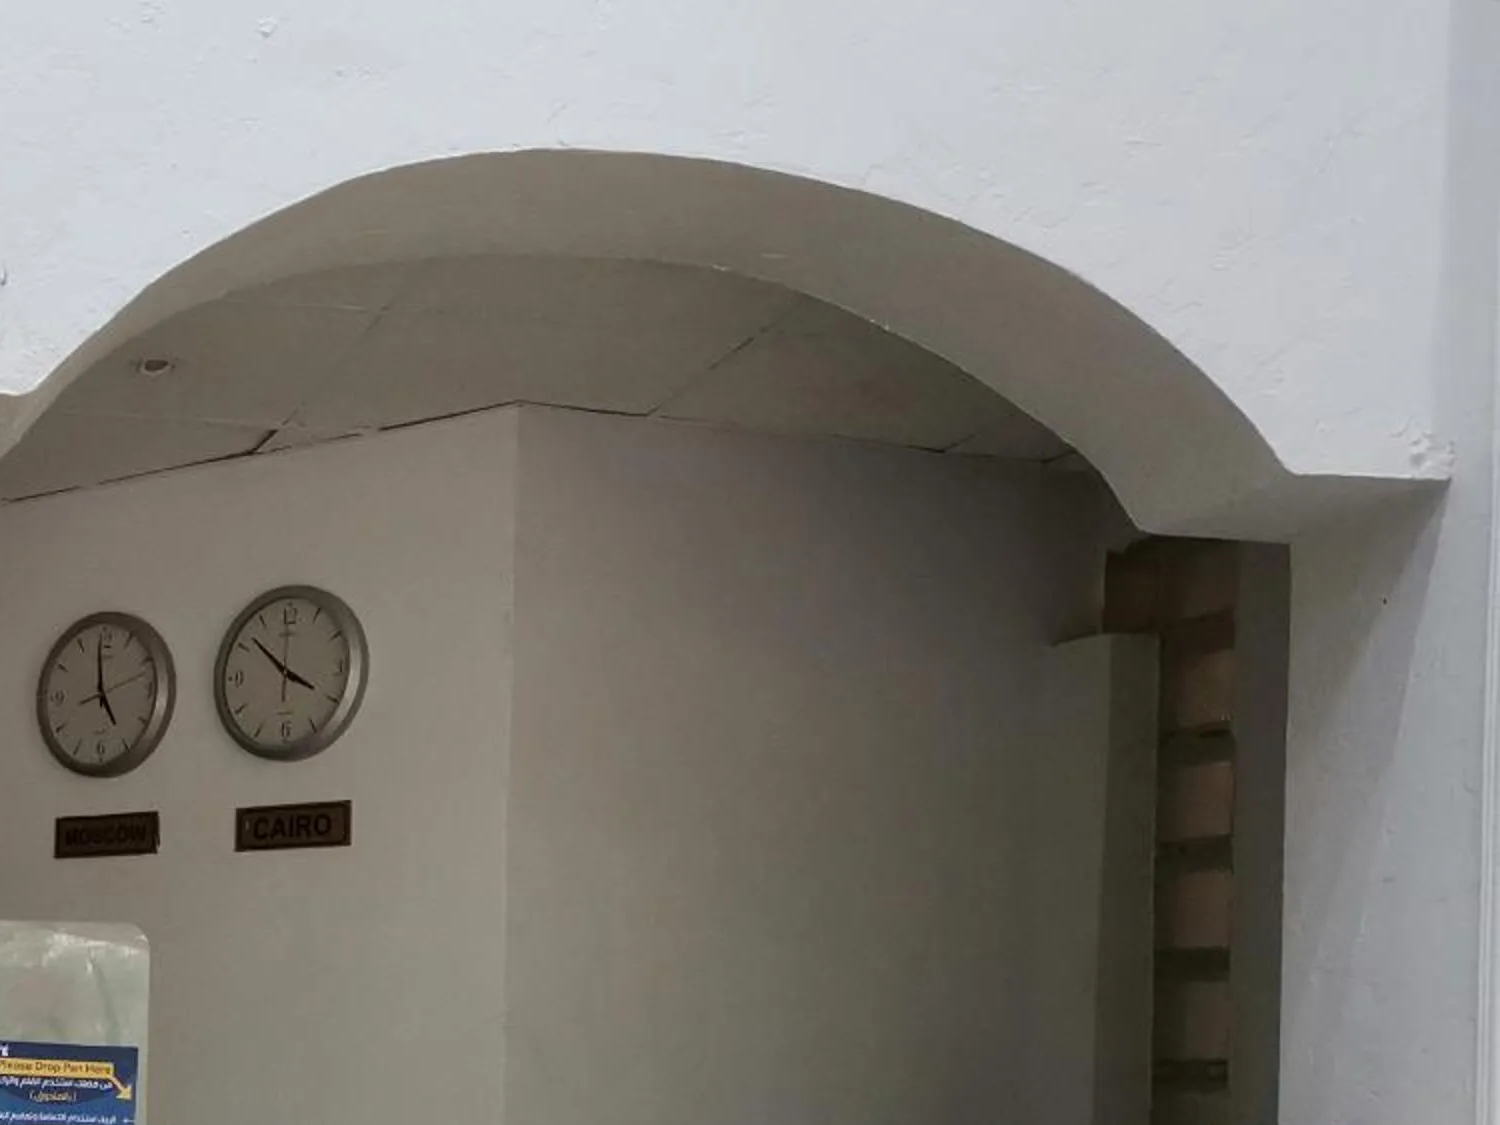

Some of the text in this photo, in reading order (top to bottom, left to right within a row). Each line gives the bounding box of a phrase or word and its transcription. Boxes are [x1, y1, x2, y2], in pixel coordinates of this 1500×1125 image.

[65, 824, 146, 846] MOSCOW
[253, 813, 332, 840] CAIRO
[35, 1062, 60, 1073] Drop
